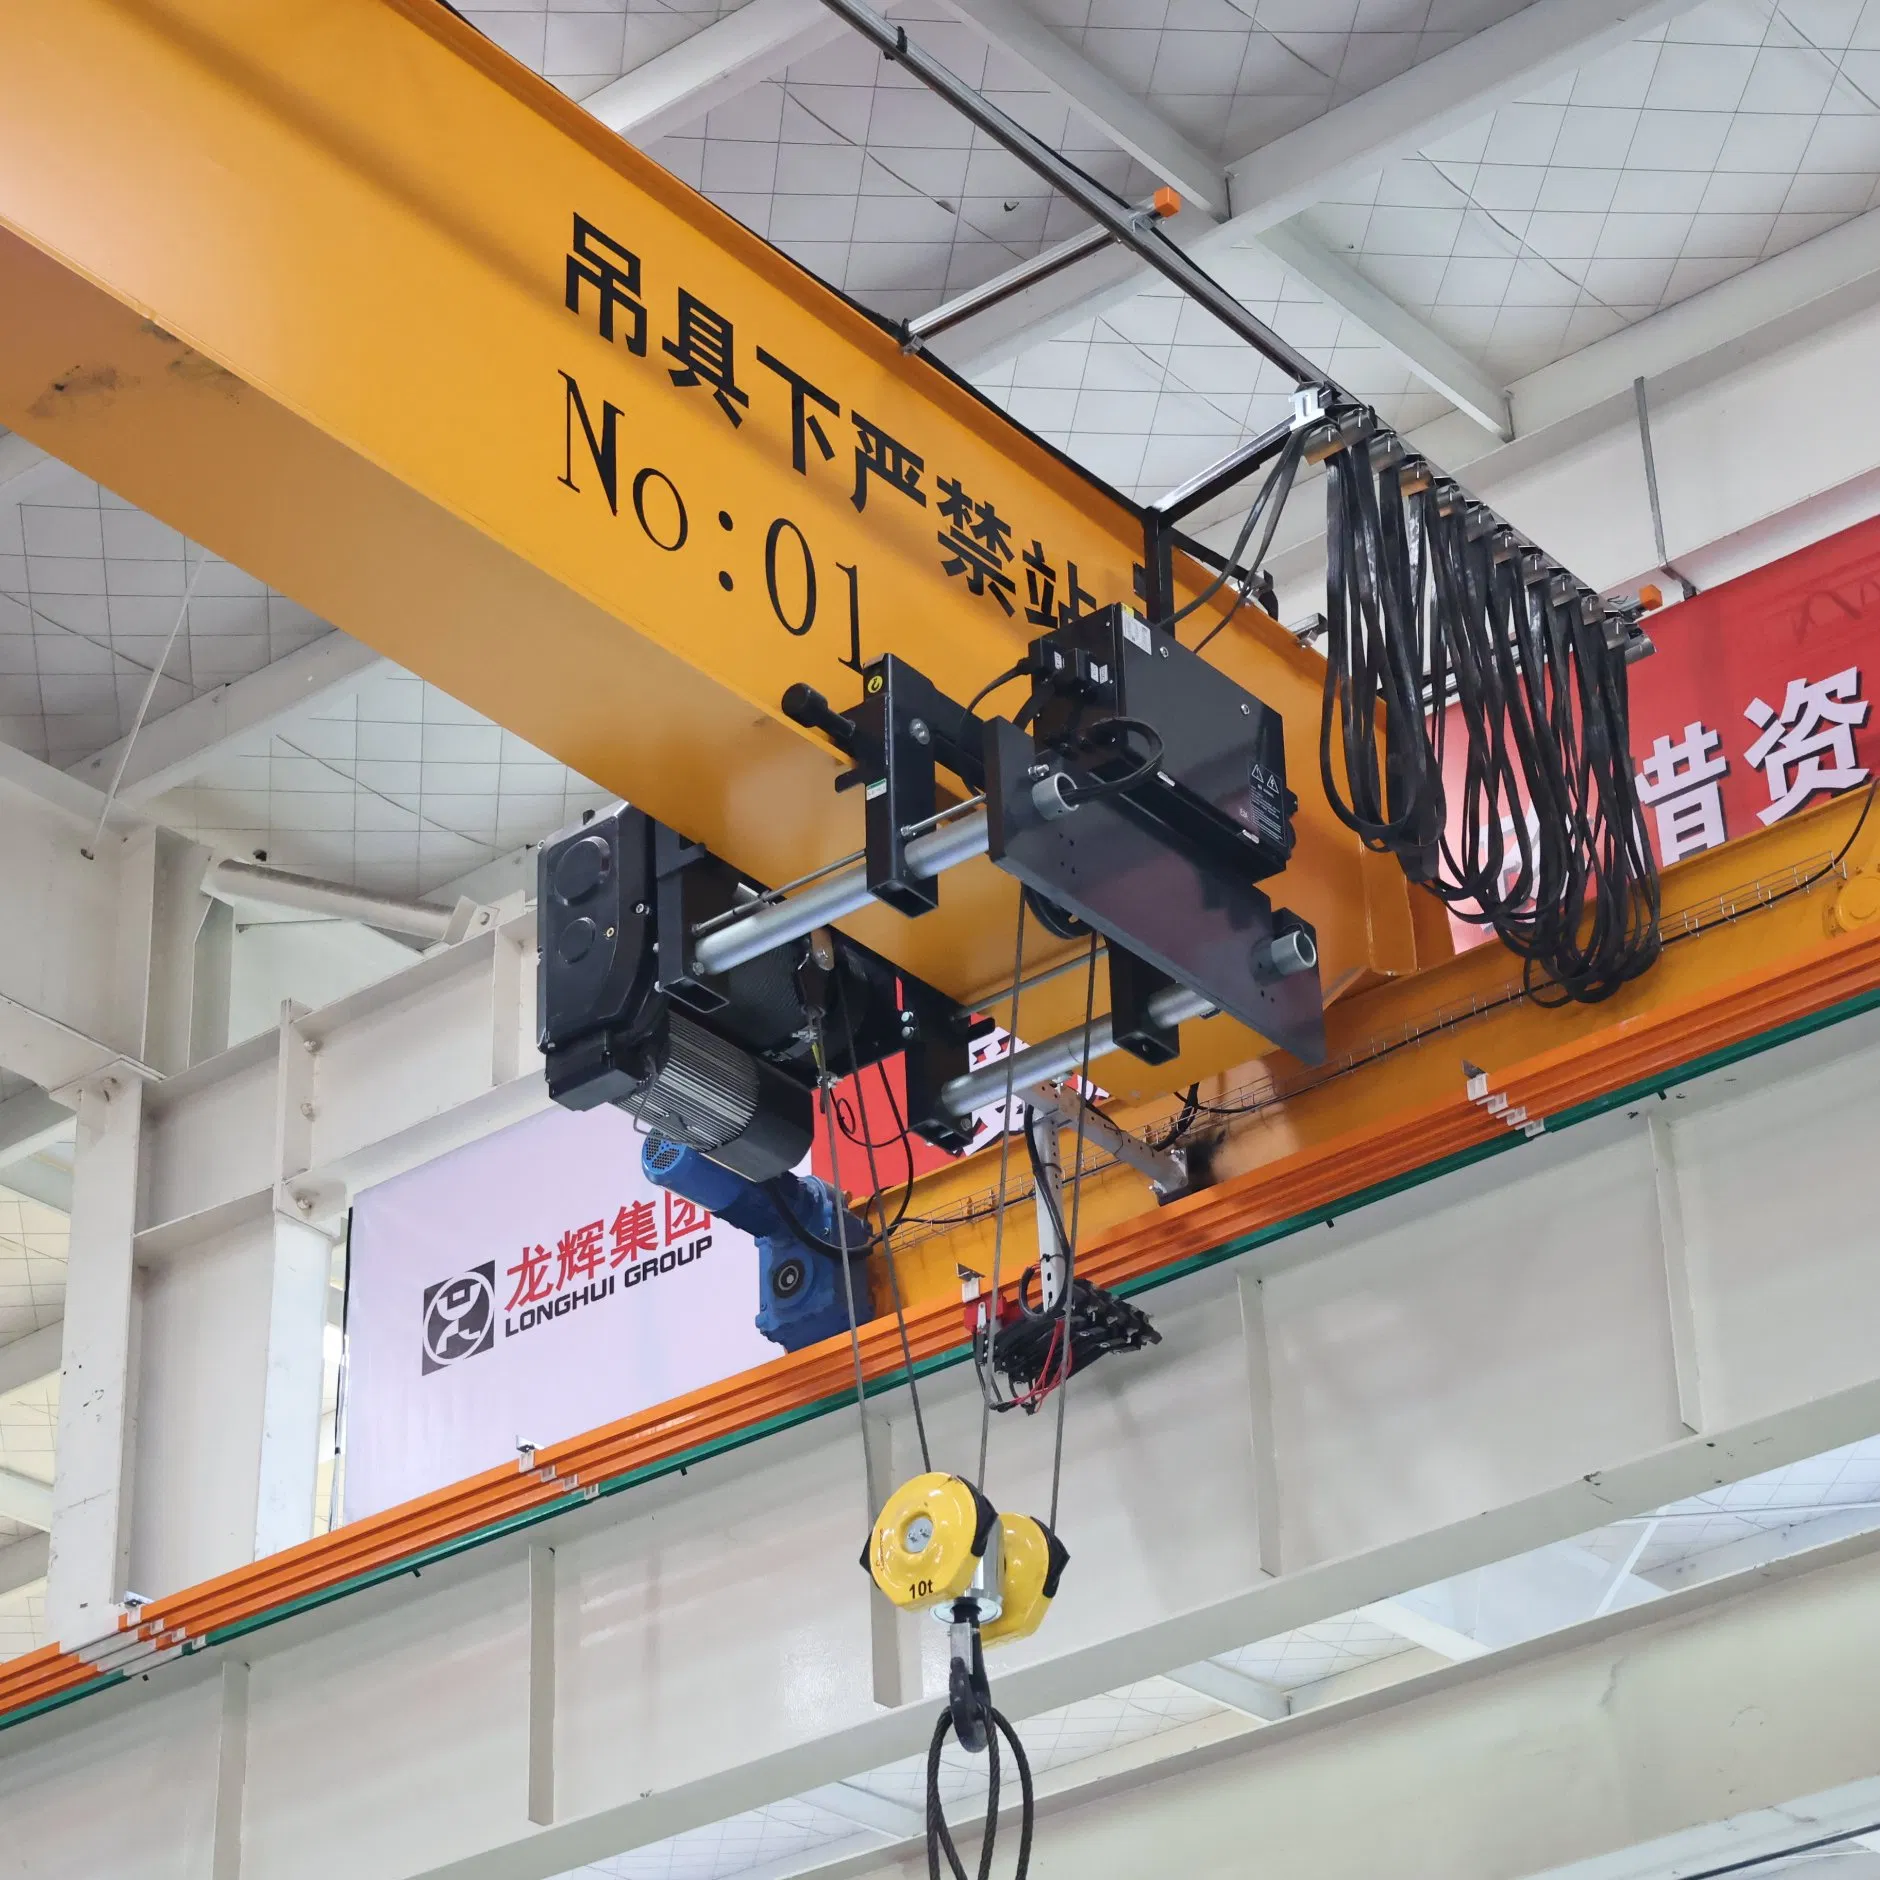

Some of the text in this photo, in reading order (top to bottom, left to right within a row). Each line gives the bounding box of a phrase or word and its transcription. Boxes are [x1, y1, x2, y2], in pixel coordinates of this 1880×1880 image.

[504, 1190, 711, 1312] 龙辉集团
[505, 1235, 713, 1338] LONGHUI GROUP
[909, 1579, 934, 1599] 10t
